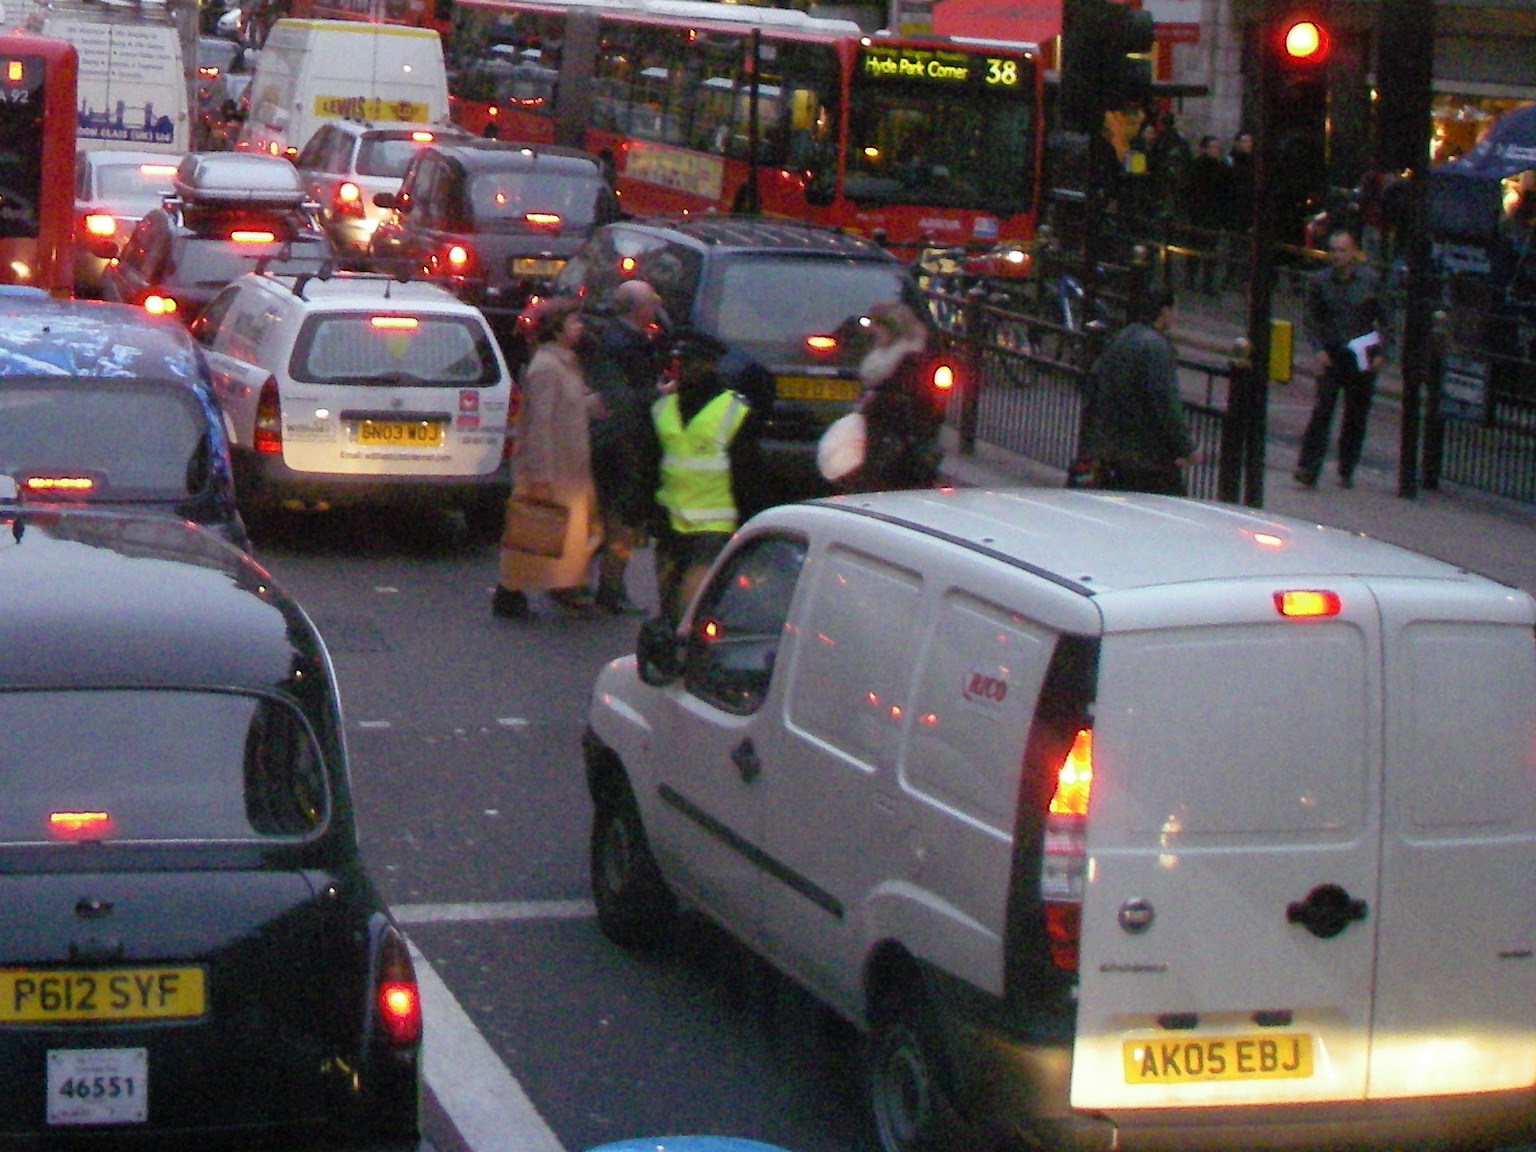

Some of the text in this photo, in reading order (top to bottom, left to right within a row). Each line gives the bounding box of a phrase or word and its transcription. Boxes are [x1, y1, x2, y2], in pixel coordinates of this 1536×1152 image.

[865, 56, 969, 80] Hyde Park Corner
[984, 58, 1018, 86] 38
[12, 89, 30, 104] 92
[14, 974, 180, 1012] P612 SYF
[1140, 1038, 1301, 1078] AK05 EBJ
[58, 1075, 135, 1099] 46551
